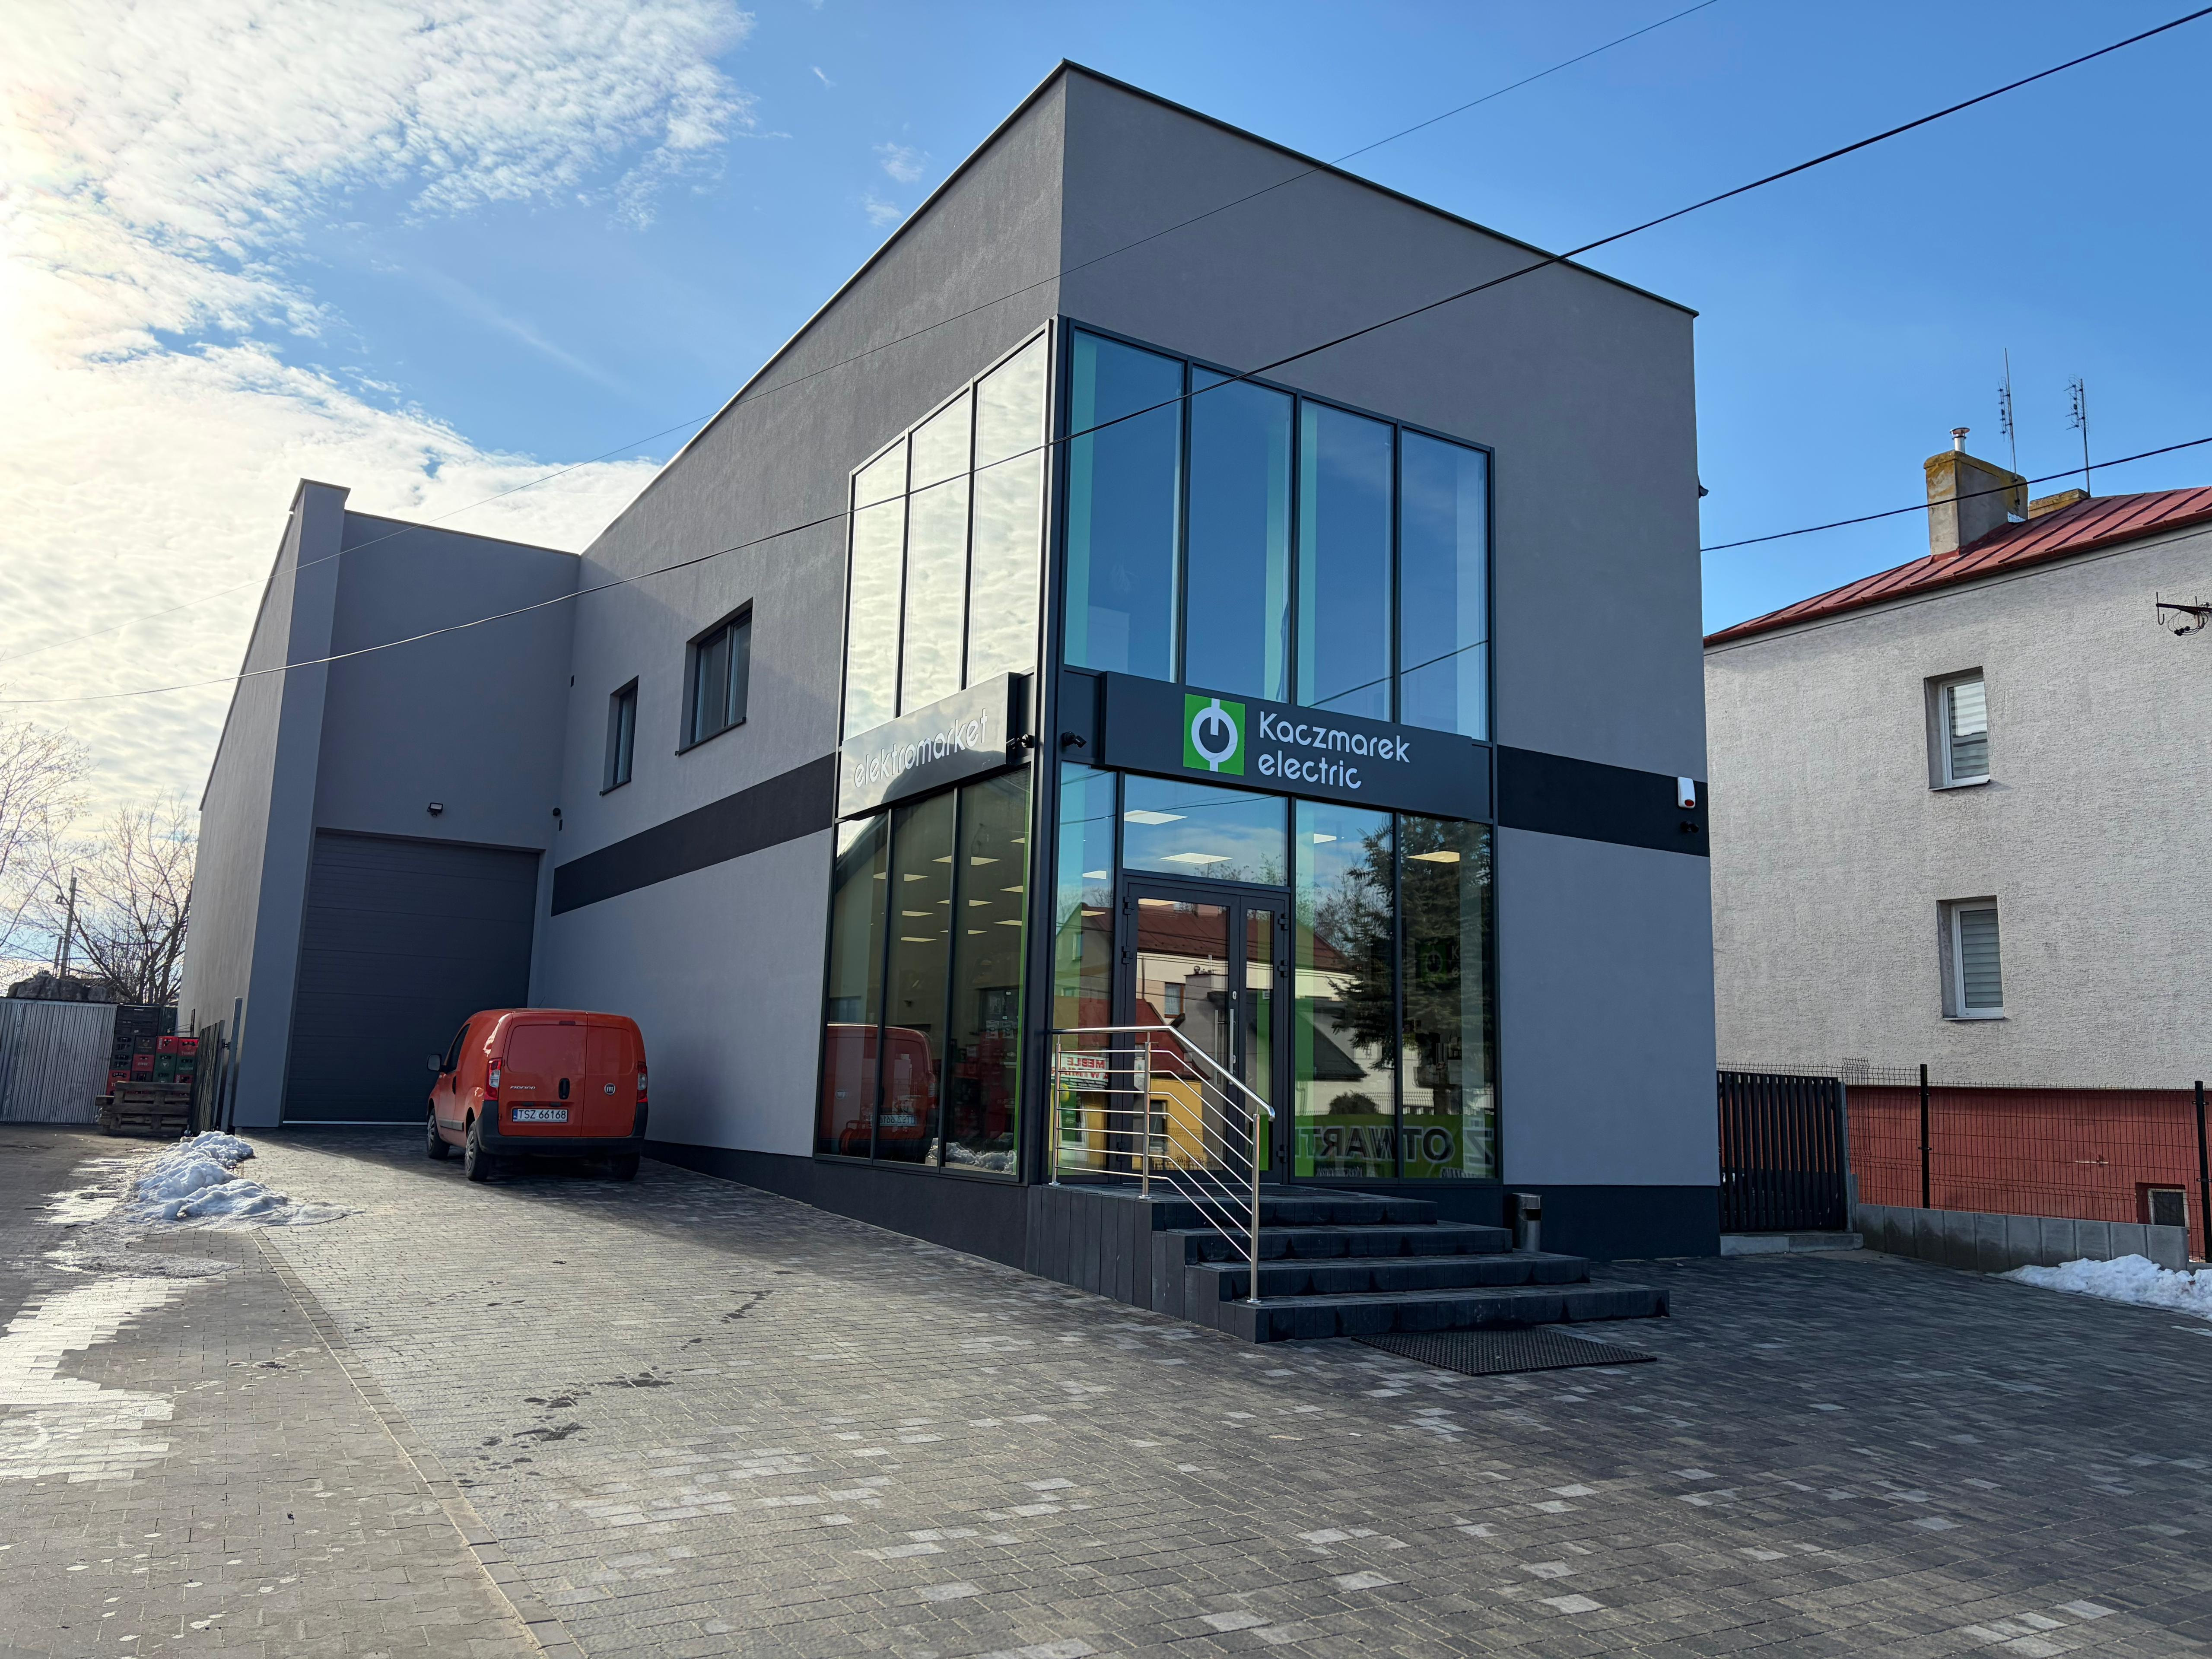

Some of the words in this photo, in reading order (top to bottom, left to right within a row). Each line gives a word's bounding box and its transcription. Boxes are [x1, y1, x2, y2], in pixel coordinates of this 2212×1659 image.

[854, 708, 988, 788] elektromarket
[1260, 711, 1411, 763] Kaczmarek
[1258, 750, 1362, 789] electric
[518, 1110, 536, 1119] TSZ
[539, 1110, 566, 1119] 66168
